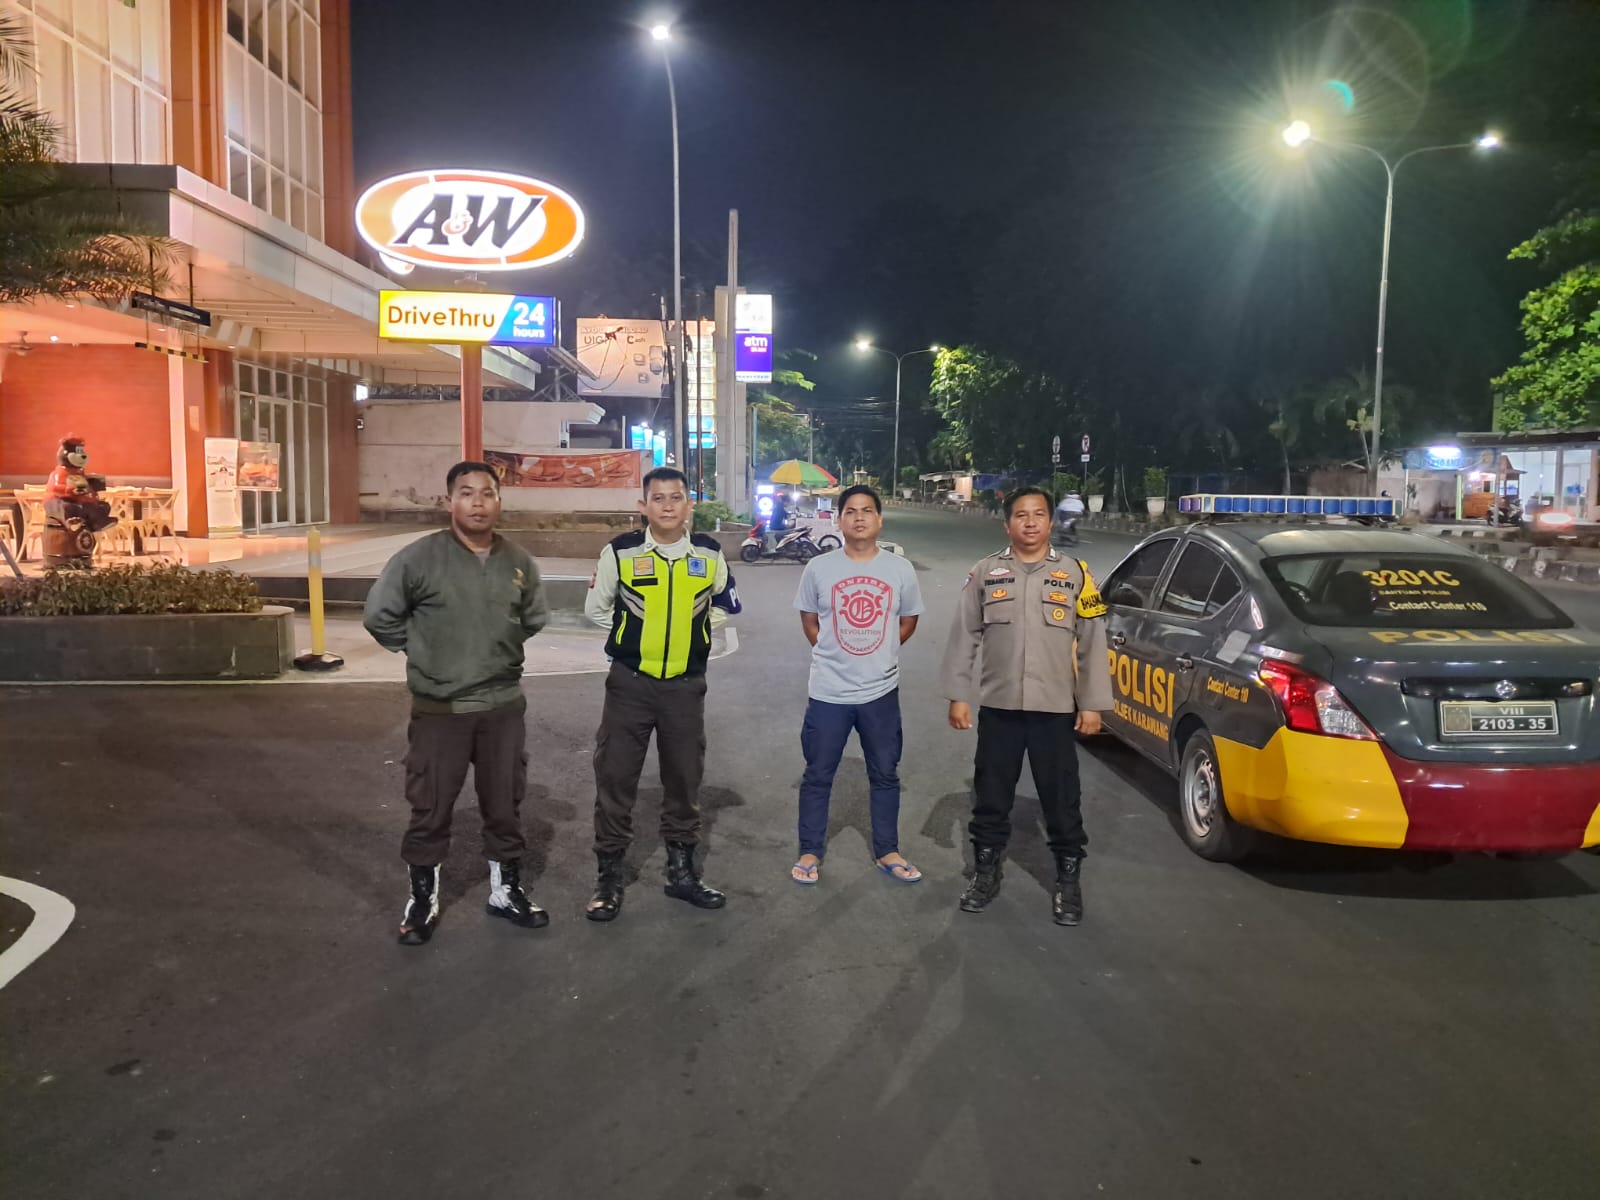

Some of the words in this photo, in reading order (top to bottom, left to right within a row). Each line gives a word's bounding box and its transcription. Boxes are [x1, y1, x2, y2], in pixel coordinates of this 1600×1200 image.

[390, 192, 548, 249] A&W
[387, 305, 496, 328] DriveThru
[512, 302, 546, 326] 24
[512, 325, 545, 338] hours
[743, 335, 769, 348] atm
[1043, 578, 1075, 590] POLRI
[1362, 569, 1460, 586] 3201C
[1389, 601, 1431, 611] Contact
[1431, 601, 1466, 611] Center
[1466, 602, 1488, 612] 110
[1368, 629, 1588, 645] POLISI
[1107, 649, 1175, 718] POLISI
[1208, 676, 1225, 694] Contact
[1225, 682, 1240, 699] Center
[1499, 707, 1525, 716] VIII
[1479, 719, 1516, 731] 2103
[1528, 719, 1547, 731] 35
